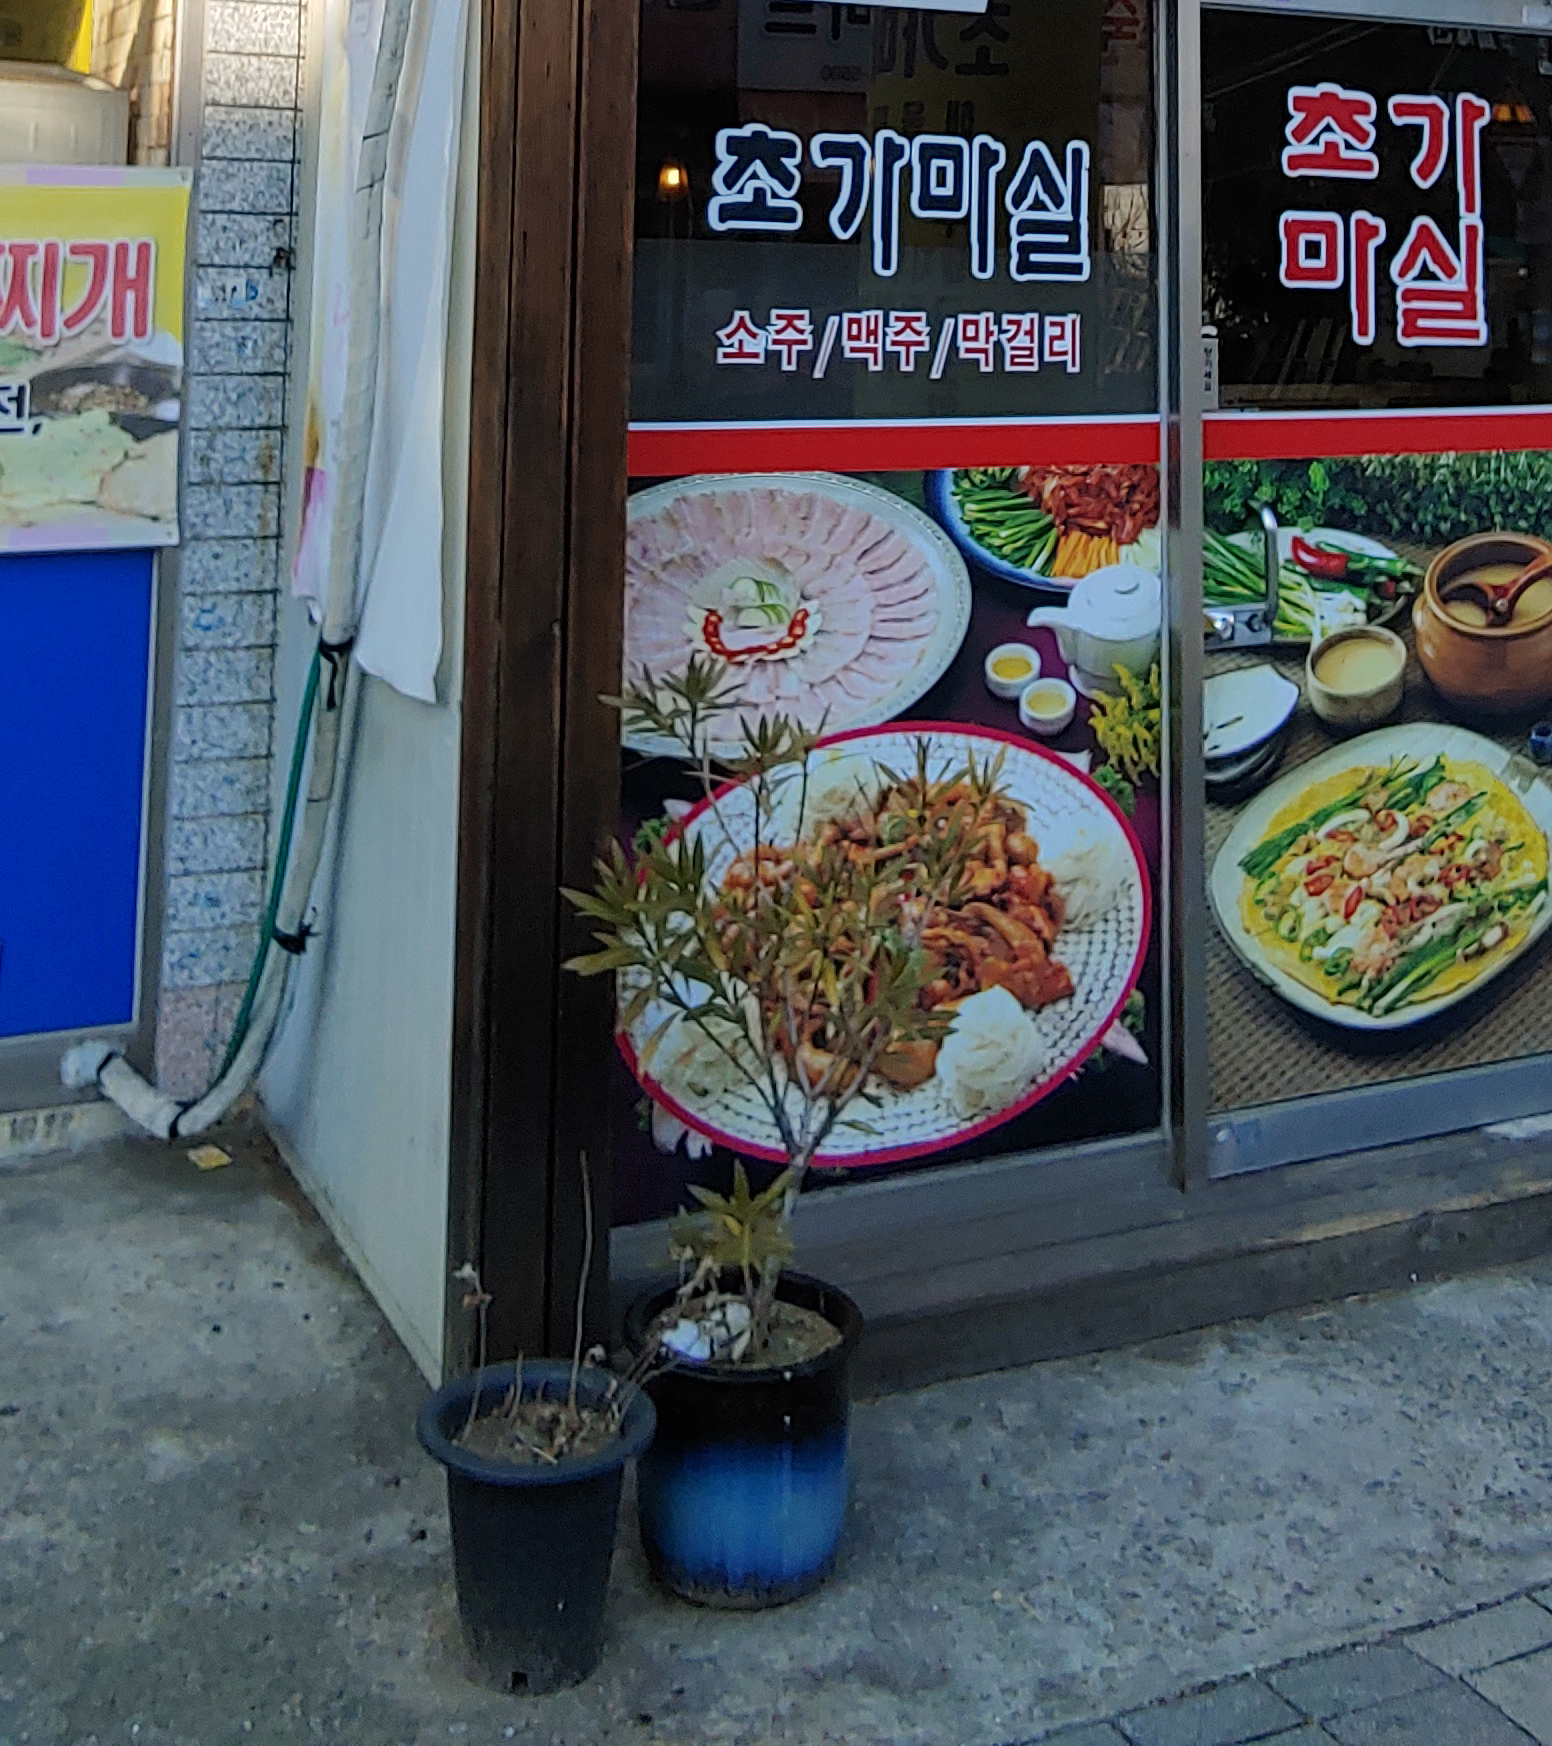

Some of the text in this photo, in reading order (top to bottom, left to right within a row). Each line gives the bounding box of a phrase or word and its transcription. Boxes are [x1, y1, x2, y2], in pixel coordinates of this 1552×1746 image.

[708, 123, 1090, 282] 초가마실
[1282, 82, 1490, 216] 초가
[716, 307, 1082, 380] 소주/맥주/막걸리
[1280, 211, 1490, 347] 마실
